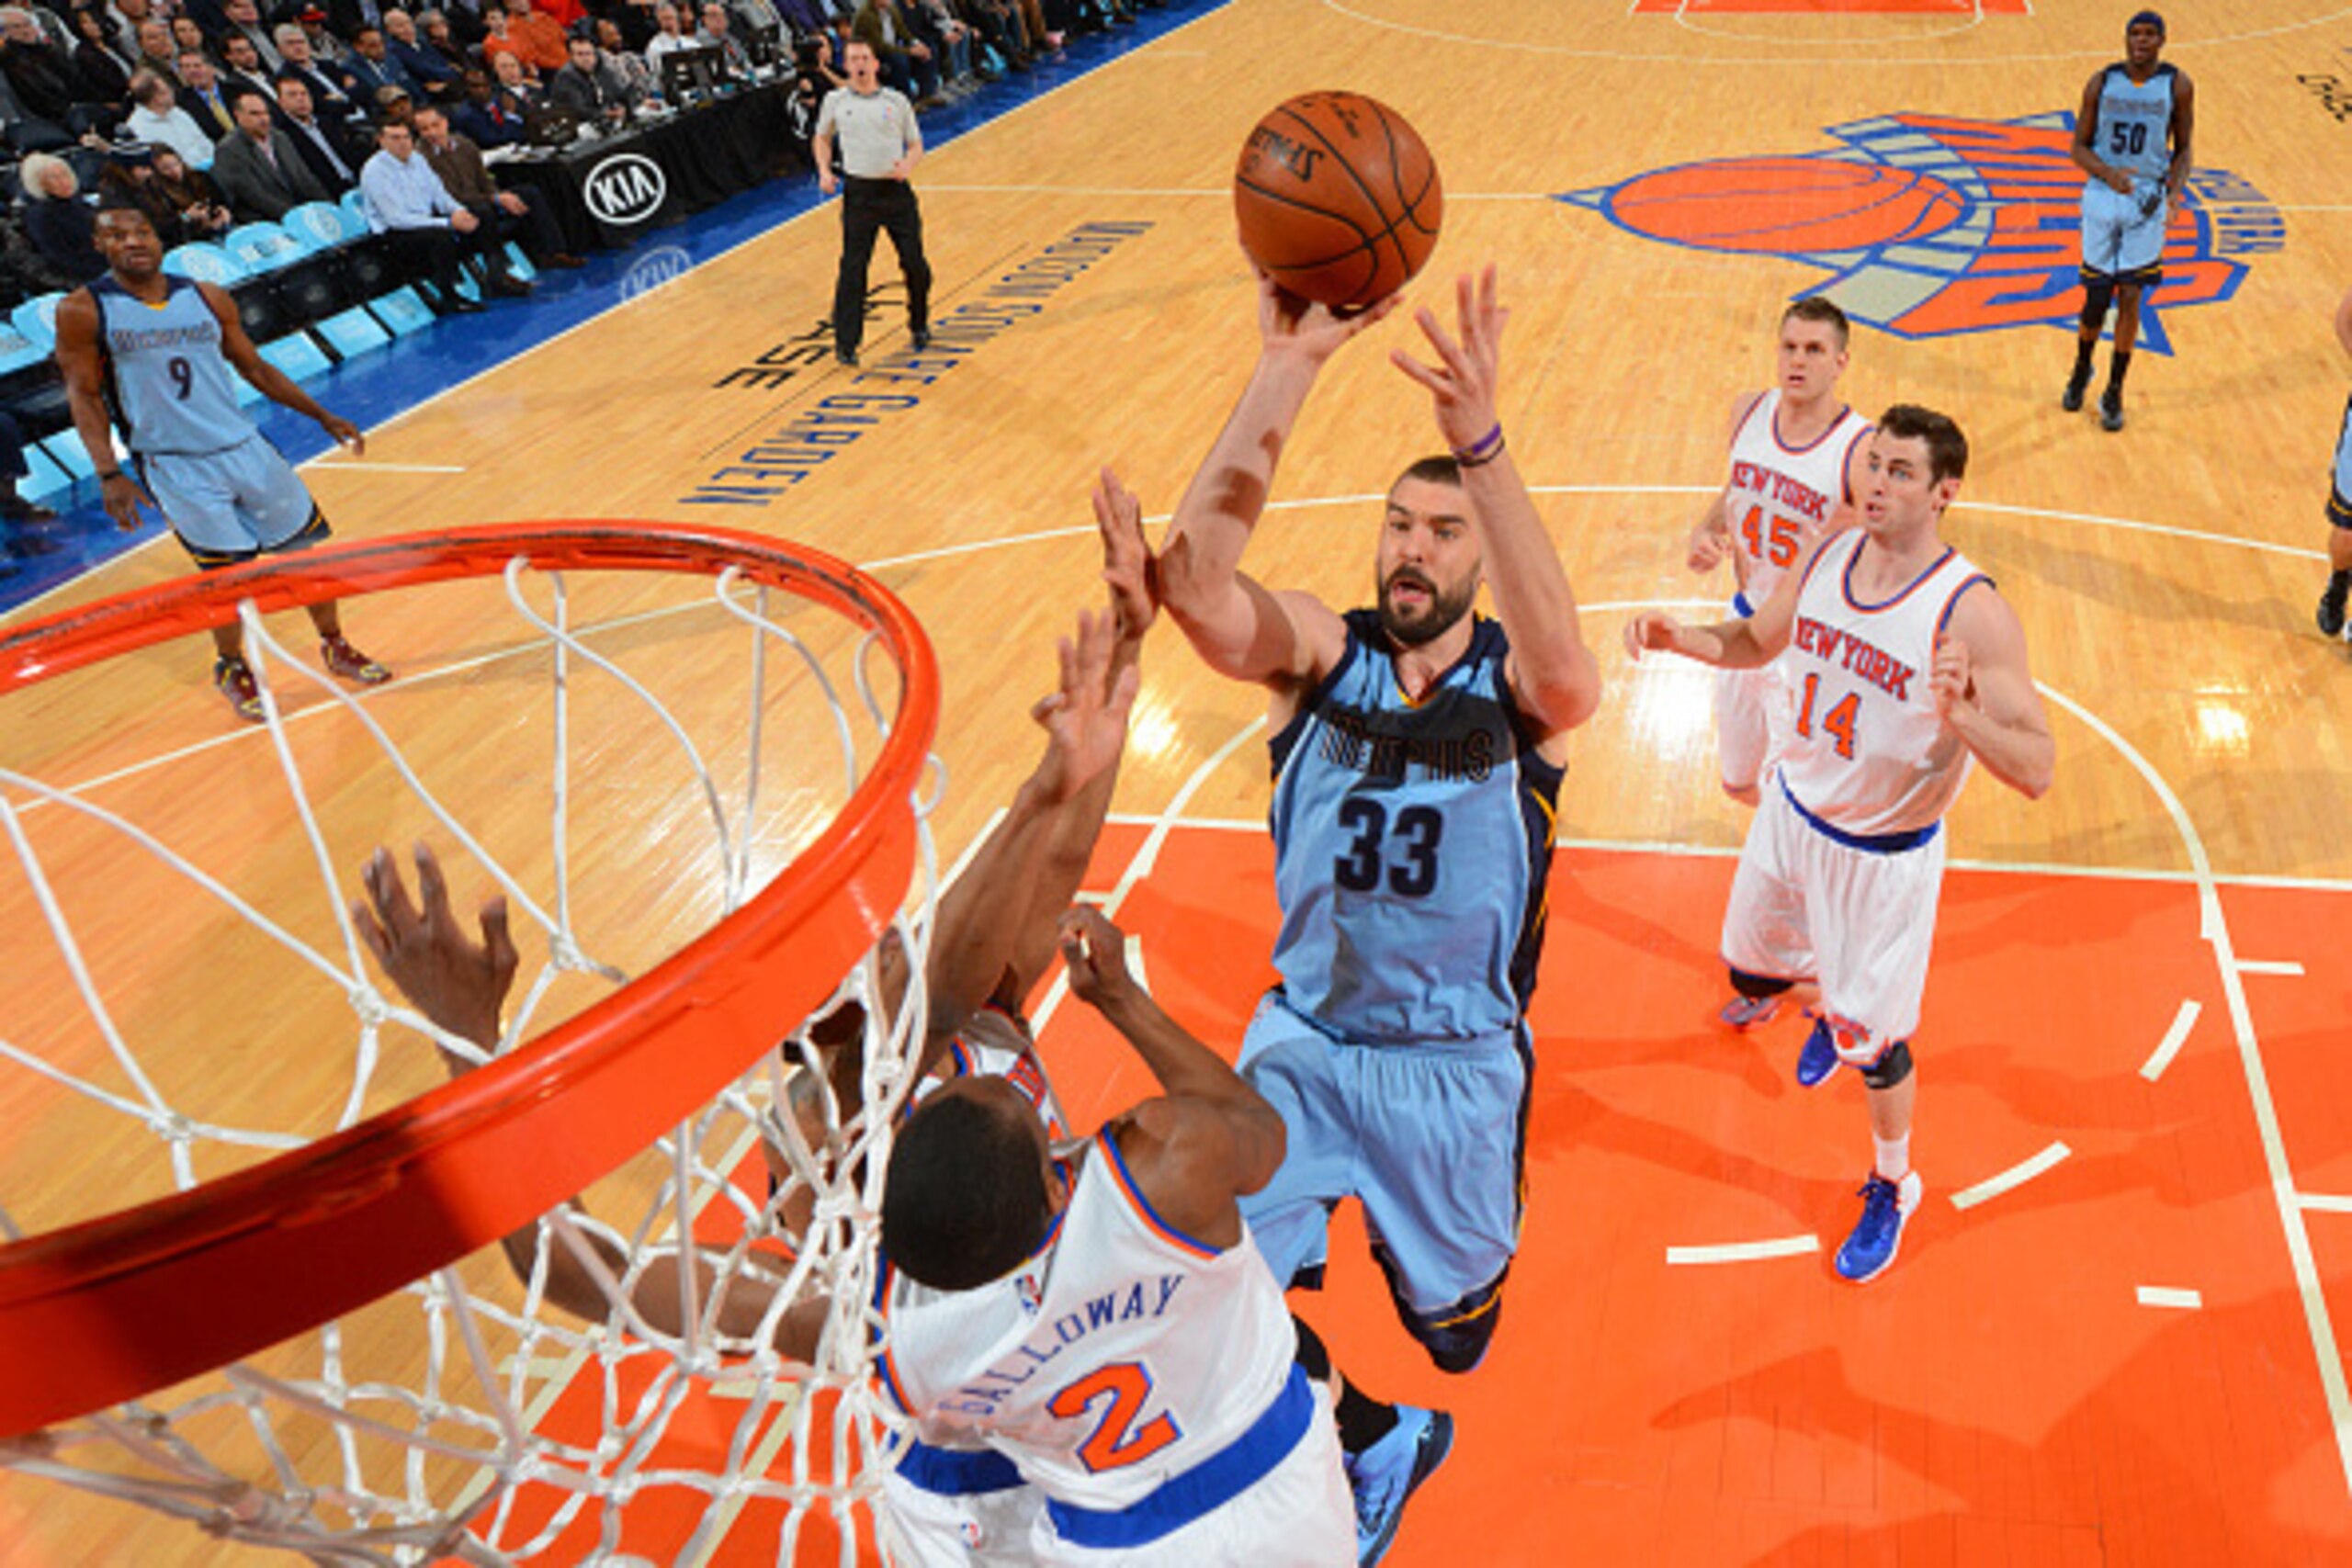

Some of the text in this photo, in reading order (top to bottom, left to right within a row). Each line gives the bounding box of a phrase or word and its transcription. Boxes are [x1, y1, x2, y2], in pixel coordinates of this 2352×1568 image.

[2110, 122, 2148, 155] 50
[594, 165, 657, 215] KIA
[980, 220, 1156, 298] MADISON
[168, 355, 191, 400] 9
[677, 394, 920, 507] GARDEN
[1771, 469, 1827, 521] YORK
[1741, 503, 1801, 569] 45
[1841, 633, 1916, 701] YORK
[1796, 671, 1862, 761] 14
[1334, 795, 1443, 898] 33
[1045, 1360, 1184, 1474] 2
